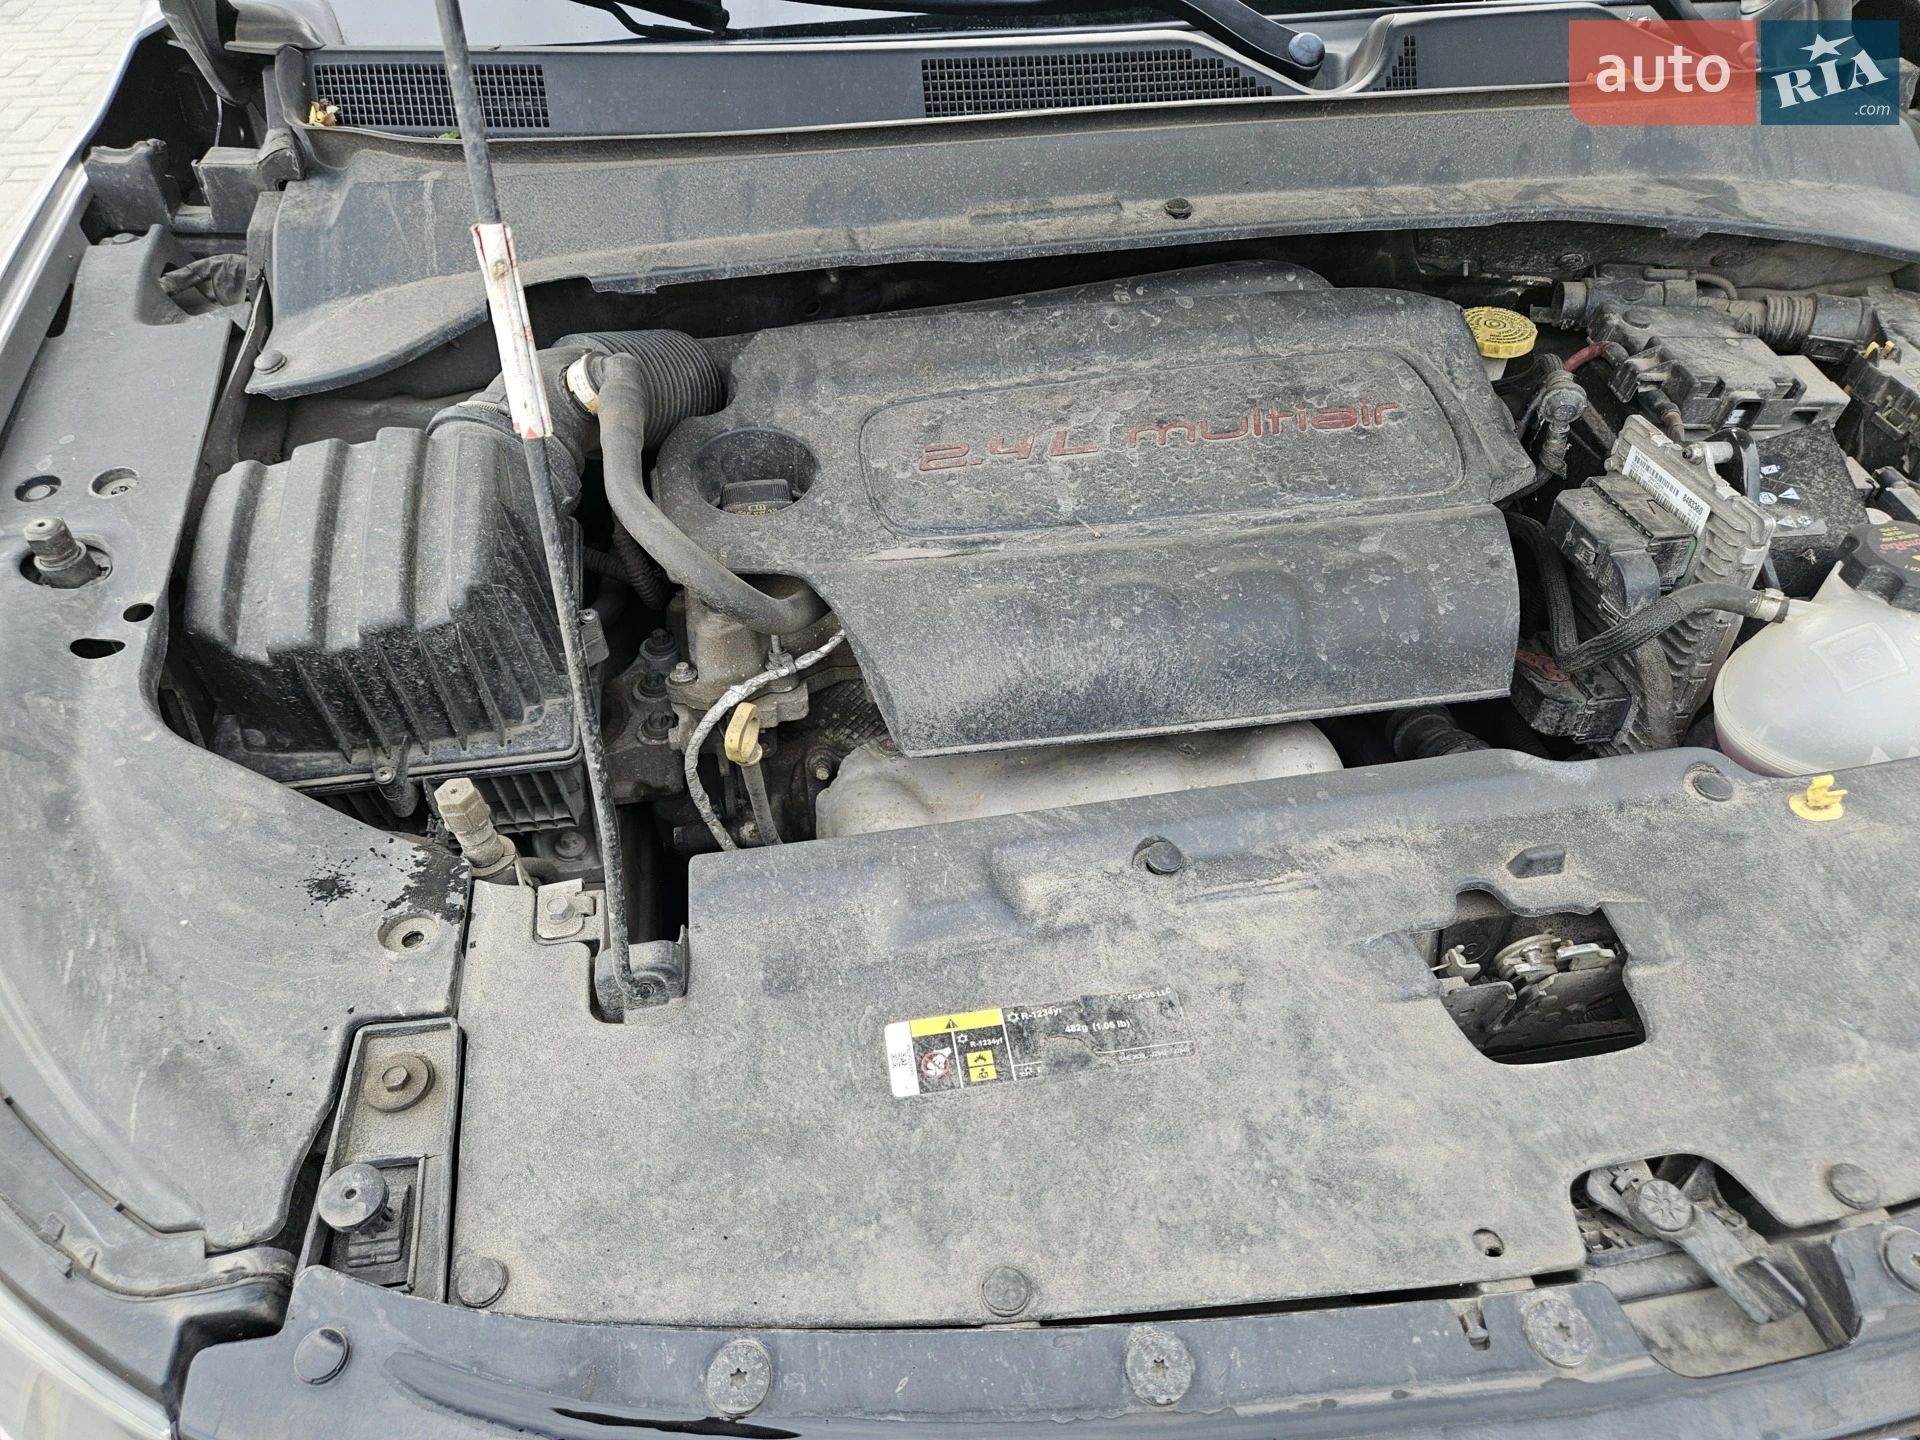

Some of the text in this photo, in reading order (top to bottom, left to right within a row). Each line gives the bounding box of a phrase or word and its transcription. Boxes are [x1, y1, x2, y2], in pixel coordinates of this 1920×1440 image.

[1129, 400, 1398, 448] multiair
[1127, 992, 1143, 1001] FCA
[1156, 987, 1172, 997] LLC
[1065, 1018, 1131, 1034] 482g (1.06 lb)
[970, 1036, 1004, 1048] R-1234yf
